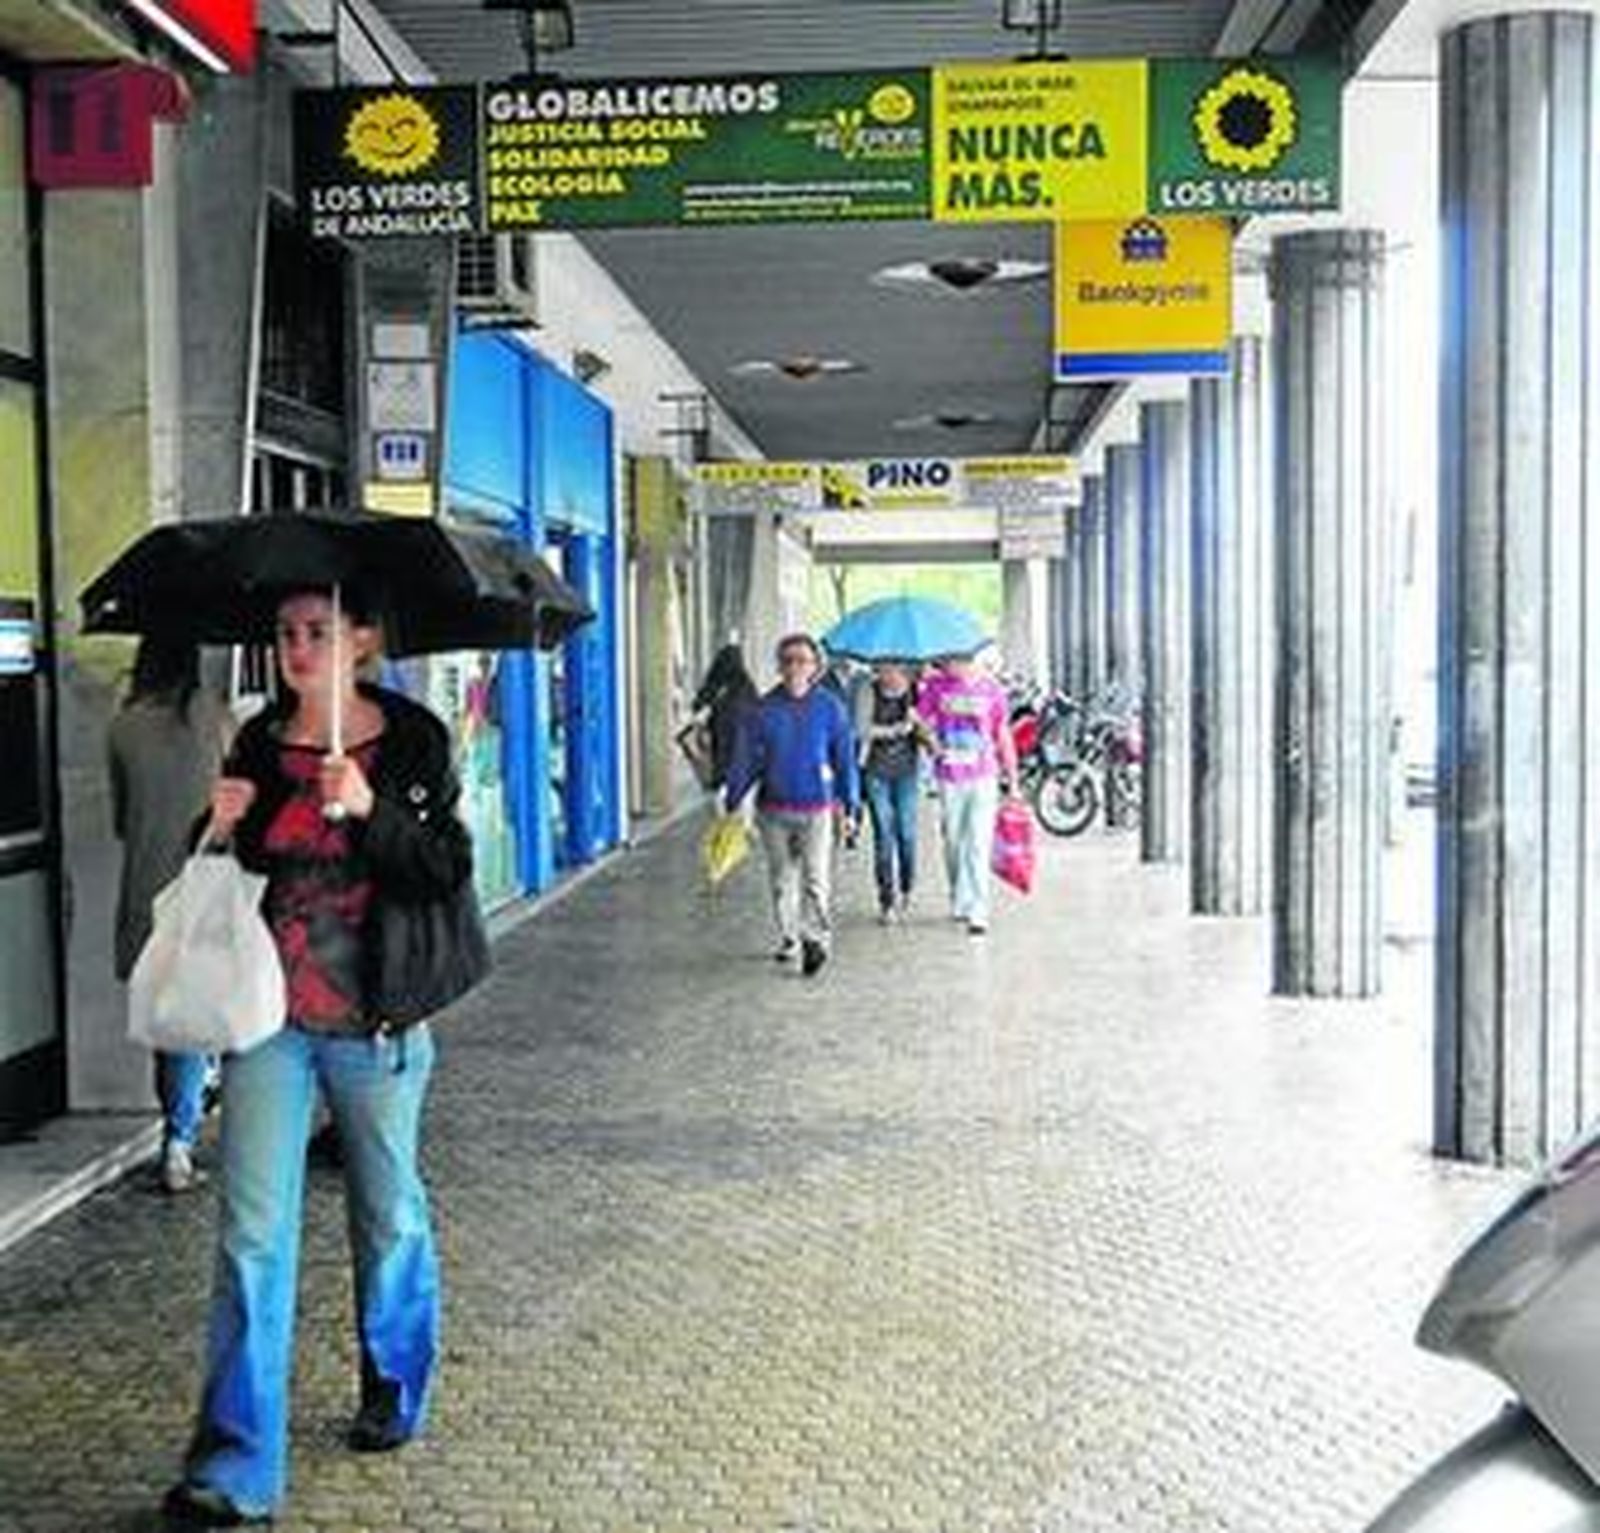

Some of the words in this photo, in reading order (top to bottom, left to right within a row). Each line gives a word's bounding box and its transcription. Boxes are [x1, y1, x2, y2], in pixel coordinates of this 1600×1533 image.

[487, 84, 779, 120] GLOBALICEMOS
[487, 123, 604, 144] JUSTICIA
[610, 119, 707, 140] SOCIAL
[948, 123, 1106, 162] NUNCA
[488, 146, 670, 171] SOLIDARIDAD
[311, 185, 364, 212] LOS
[367, 181, 470, 208] VERDES
[1161, 181, 1216, 206] LOS
[1221, 177, 1330, 204] VERDES
[312, 217, 340, 236] DE
[867, 461, 951, 488] PINO
